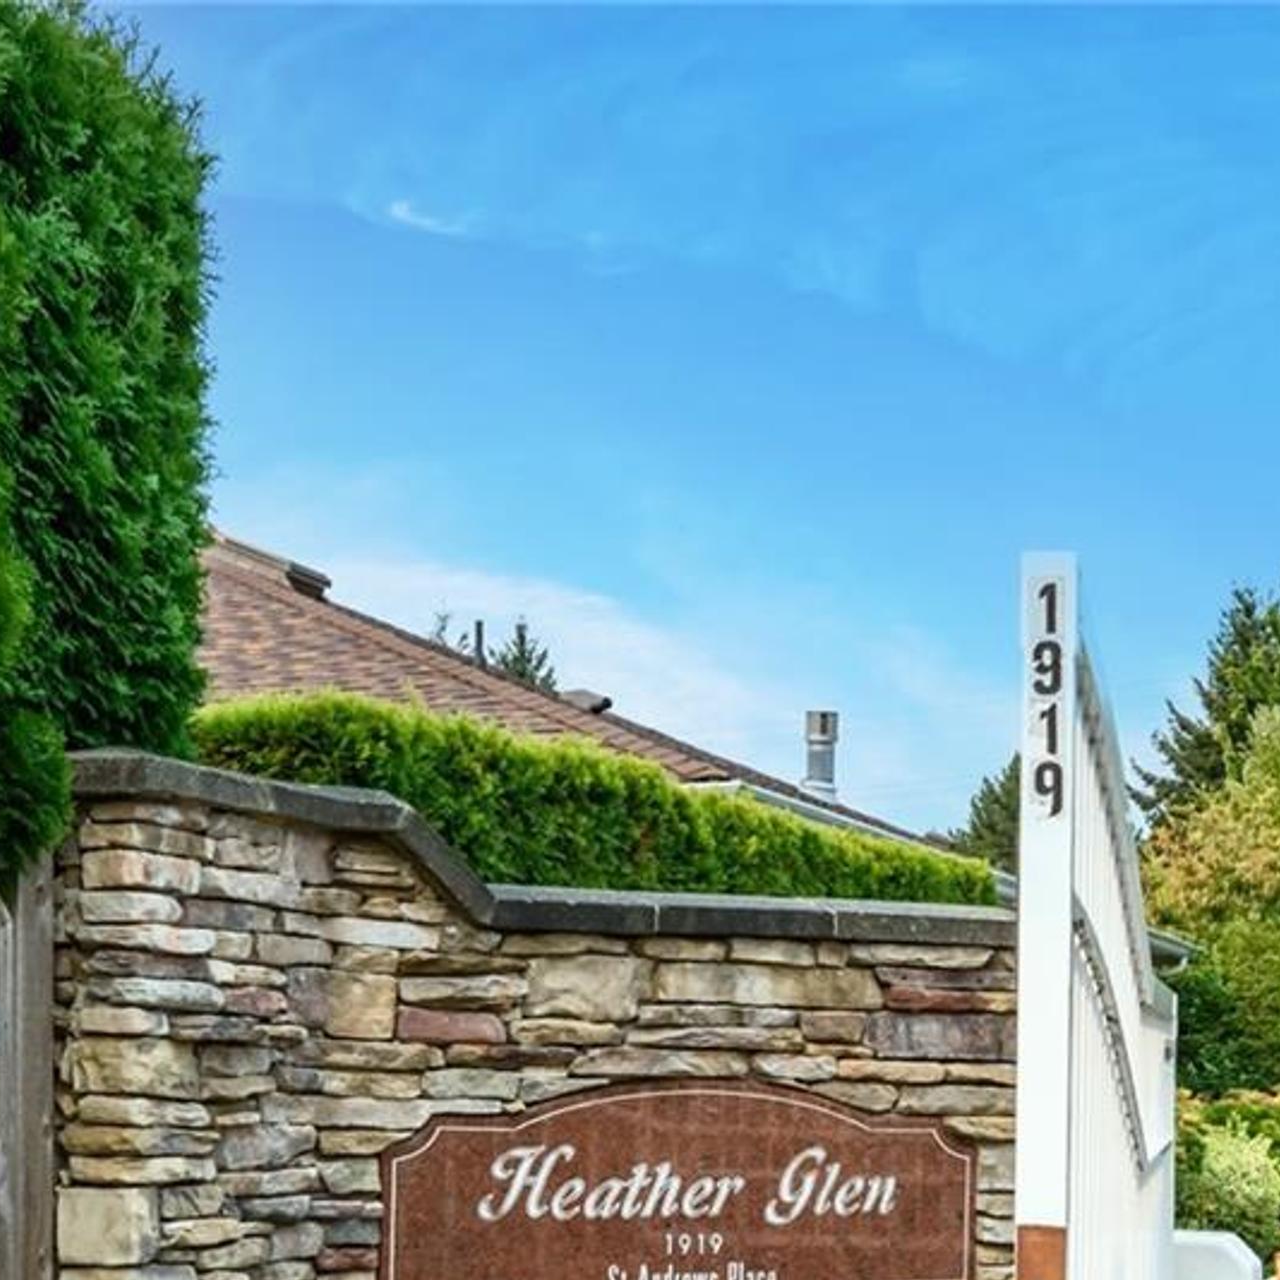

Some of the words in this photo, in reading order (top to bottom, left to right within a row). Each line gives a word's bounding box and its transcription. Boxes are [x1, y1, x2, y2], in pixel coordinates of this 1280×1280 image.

[1032, 582, 1064, 818] 1919
[477, 1143, 746, 1222] Heather
[763, 1145, 898, 1226] Glen
[664, 1232, 724, 1256] 1919
